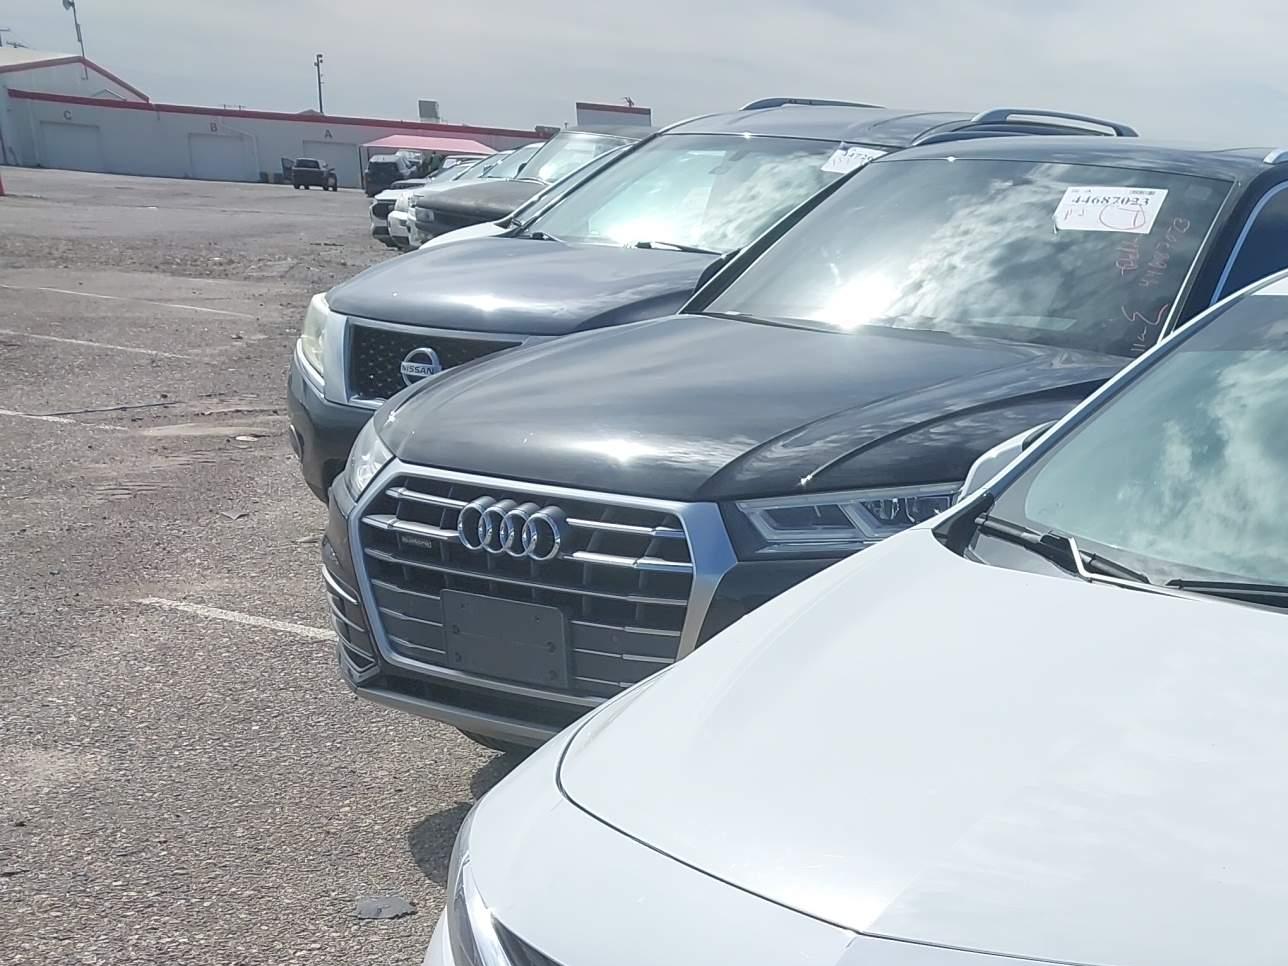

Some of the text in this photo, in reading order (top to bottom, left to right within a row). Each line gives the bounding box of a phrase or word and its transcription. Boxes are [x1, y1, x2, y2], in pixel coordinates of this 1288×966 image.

[63, 109, 72, 120] C
[210, 122, 218, 133] B
[324, 129, 333, 139] A
[1072, 195, 1150, 206] 44687023
[402, 364, 434, 375] NISSAN
